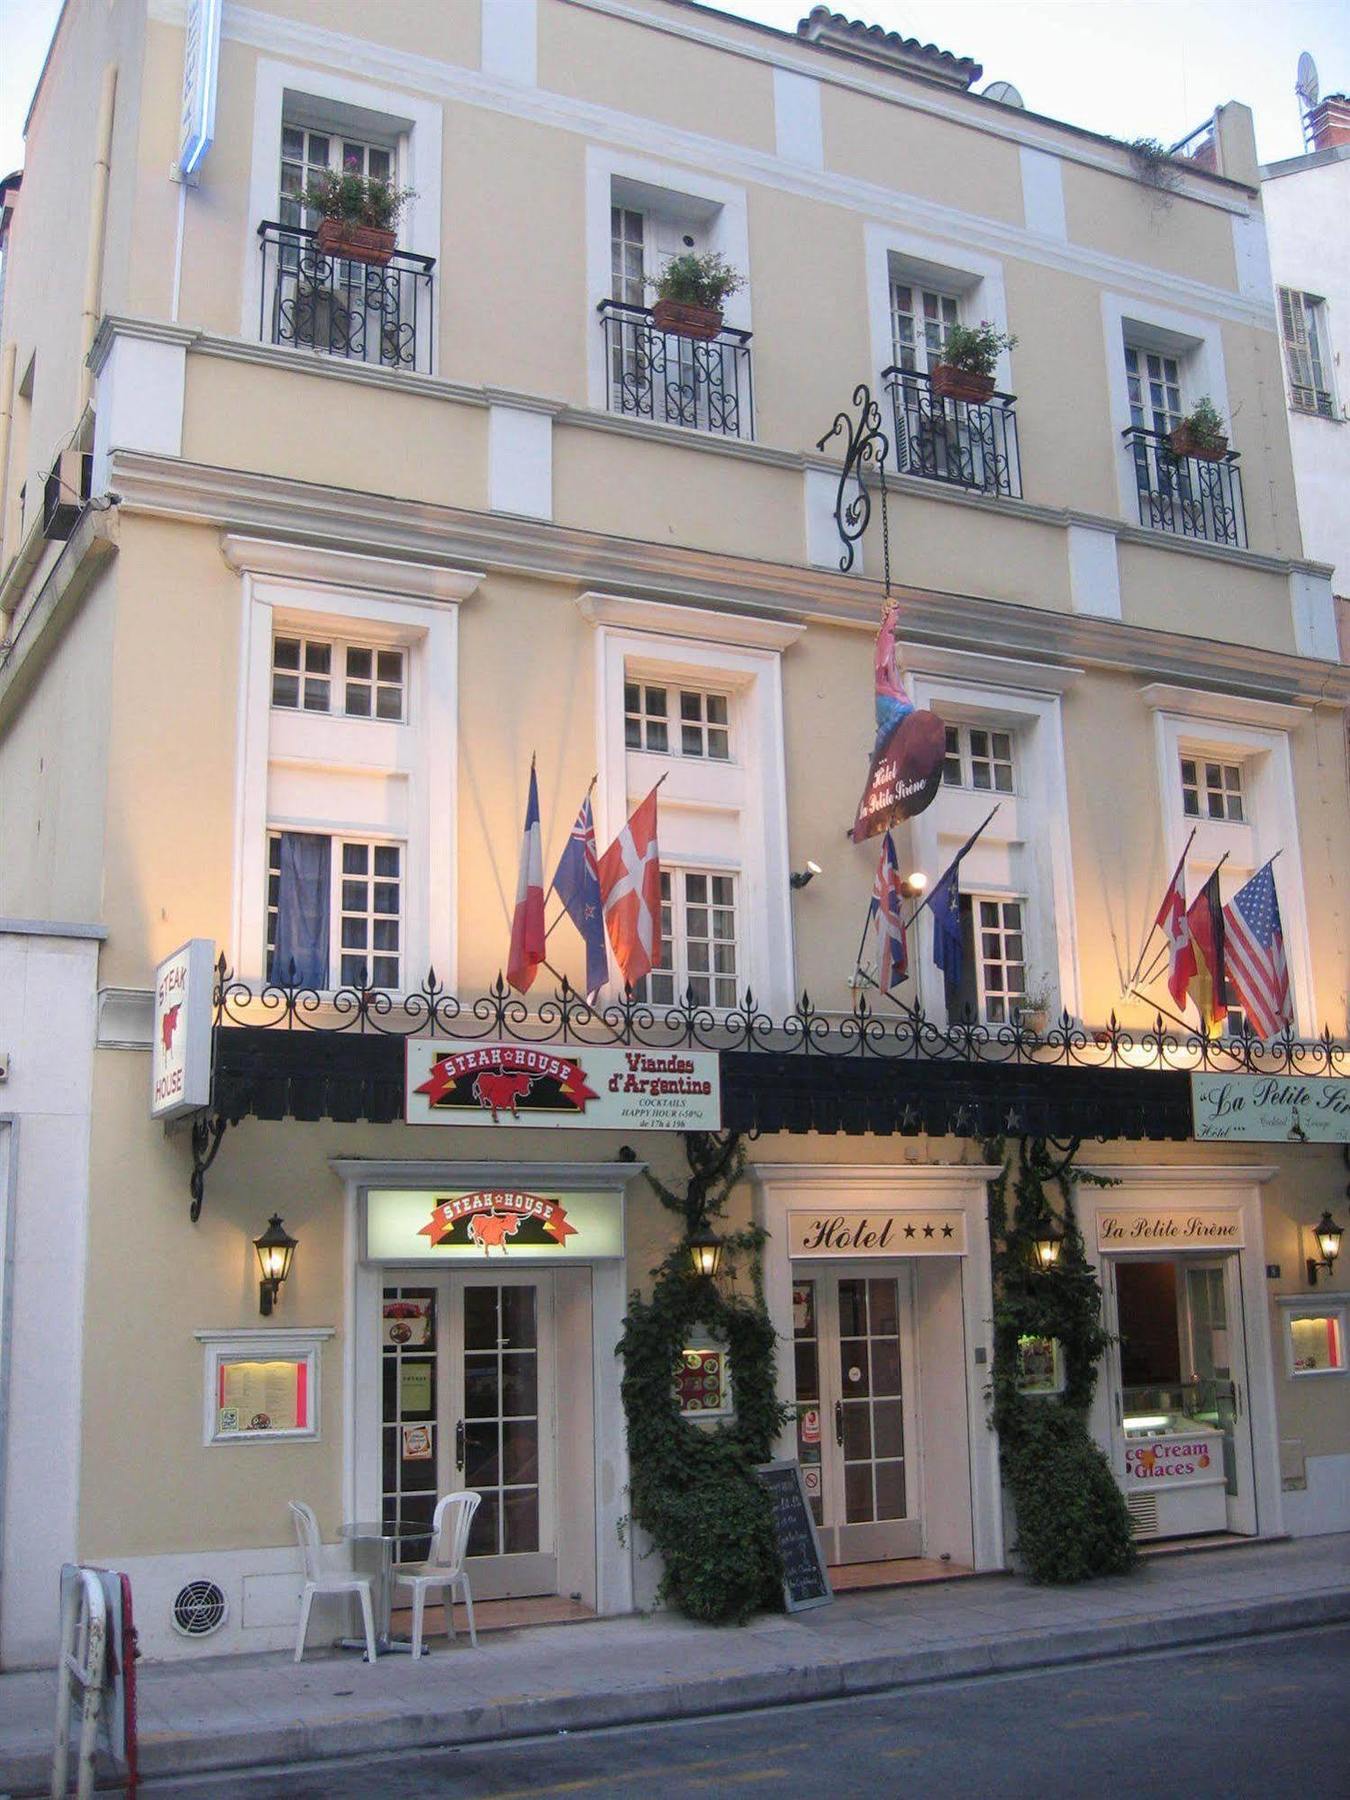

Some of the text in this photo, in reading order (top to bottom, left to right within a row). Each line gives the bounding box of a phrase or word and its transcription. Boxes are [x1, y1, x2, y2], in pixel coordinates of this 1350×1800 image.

[158, 967, 187, 1006] STEAK
[515, 1049, 571, 1080] HOUSE
[625, 1052, 695, 1074] Viandes
[154, 1069, 183, 1103] HOUSE
[608, 1073, 711, 1096] d'Argentine
[1253, 1078, 1311, 1108] Petite
[621, 1108, 650, 1117] HAPPY
[652, 1109, 677, 1118] HOUR
[639, 1099, 688, 1108] COCKTAILS
[504, 1193, 554, 1218] HOUSE
[803, 1216, 896, 1249] Hôtel
[1102, 1216, 1239, 1239] La Petite Sirène
[1151, 1443, 1208, 1459] Cream
[1134, 1462, 1195, 1479] Glaces
